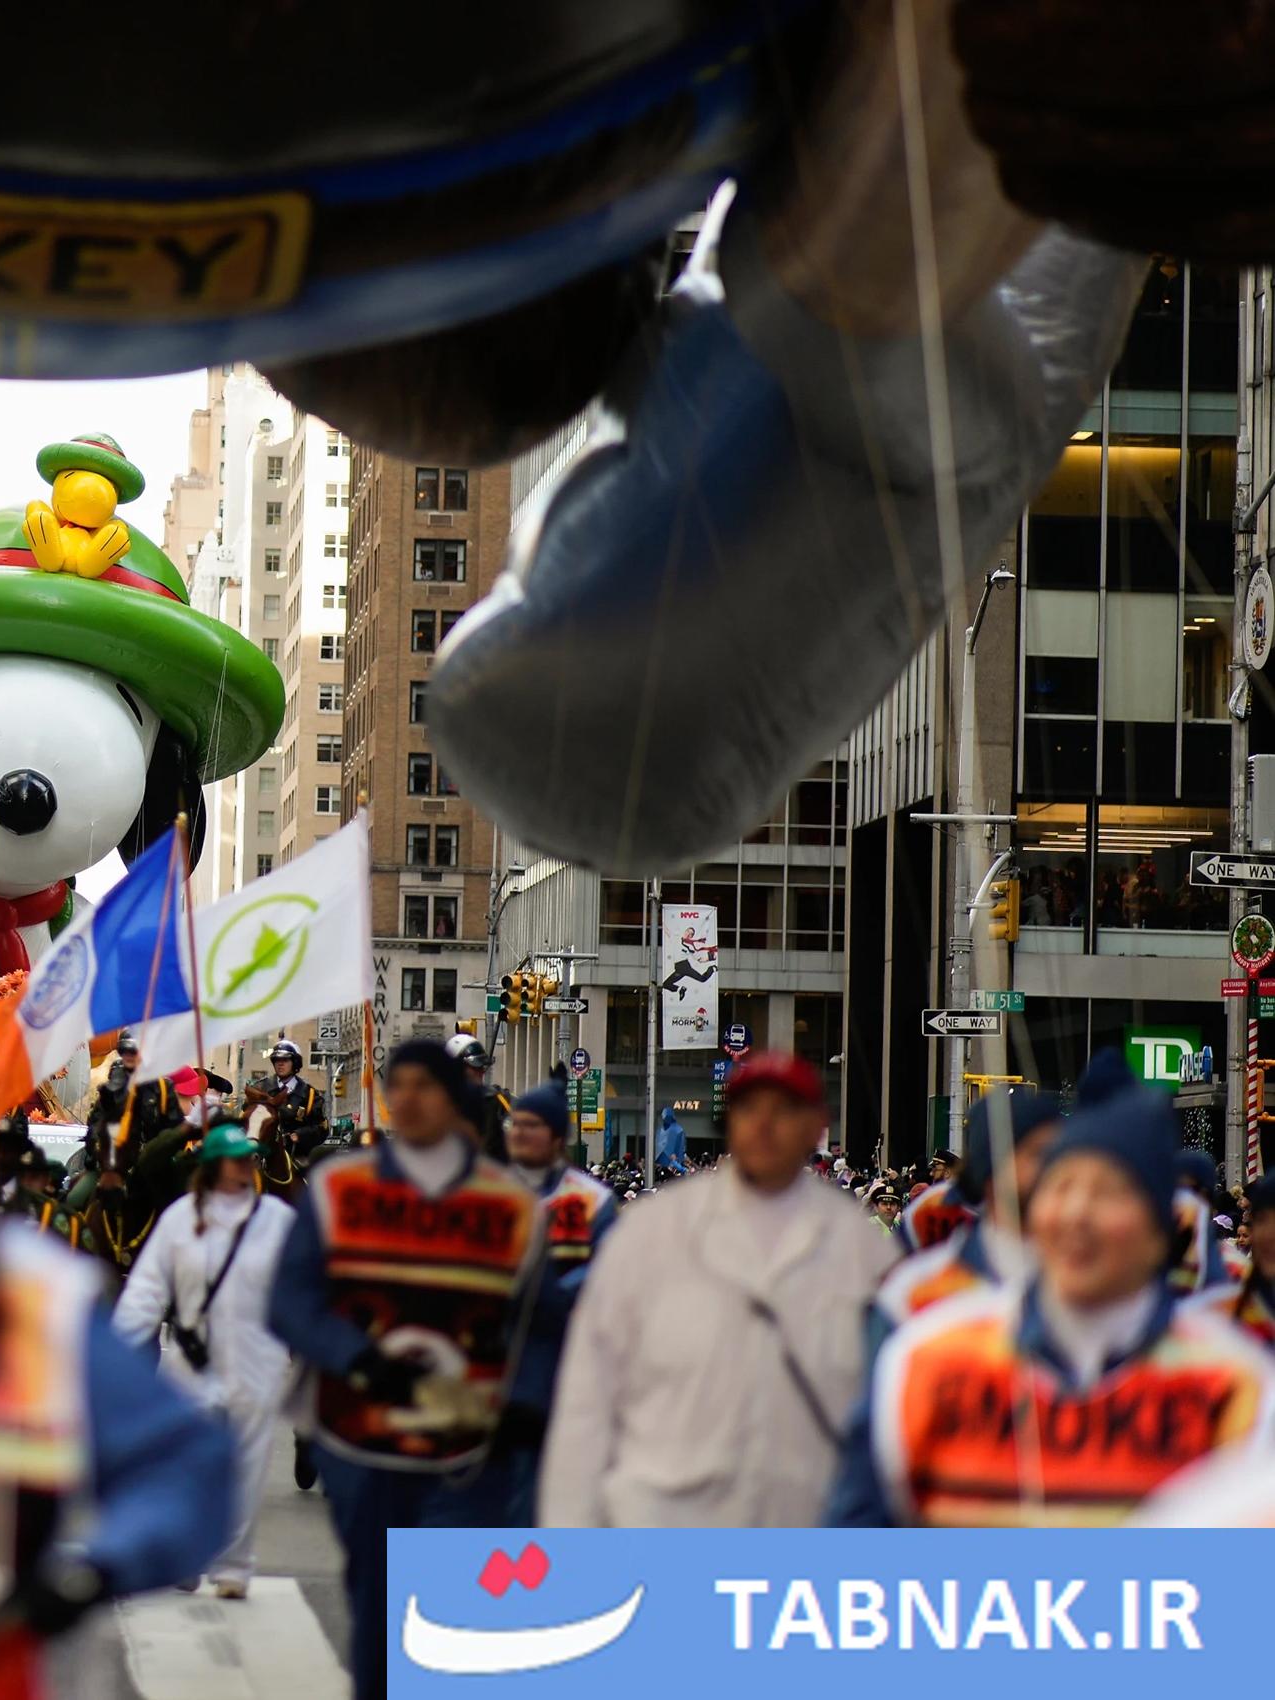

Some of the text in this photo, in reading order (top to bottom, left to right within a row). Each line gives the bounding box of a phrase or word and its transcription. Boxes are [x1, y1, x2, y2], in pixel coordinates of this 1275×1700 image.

[1207, 863, 1235, 877] ONE
[986, 993, 1022, 1009] W 51 St
[372, 955, 391, 1081] WARWICK
[938, 1018, 993, 1028] ONE WAY
[320, 1027, 338, 1038] 25
[1131, 1037, 1194, 1080] TD
[714, 1062, 725, 1070] M5
[714, 1073, 725, 1081] M7
[673, 1100, 700, 1110] AT&T
